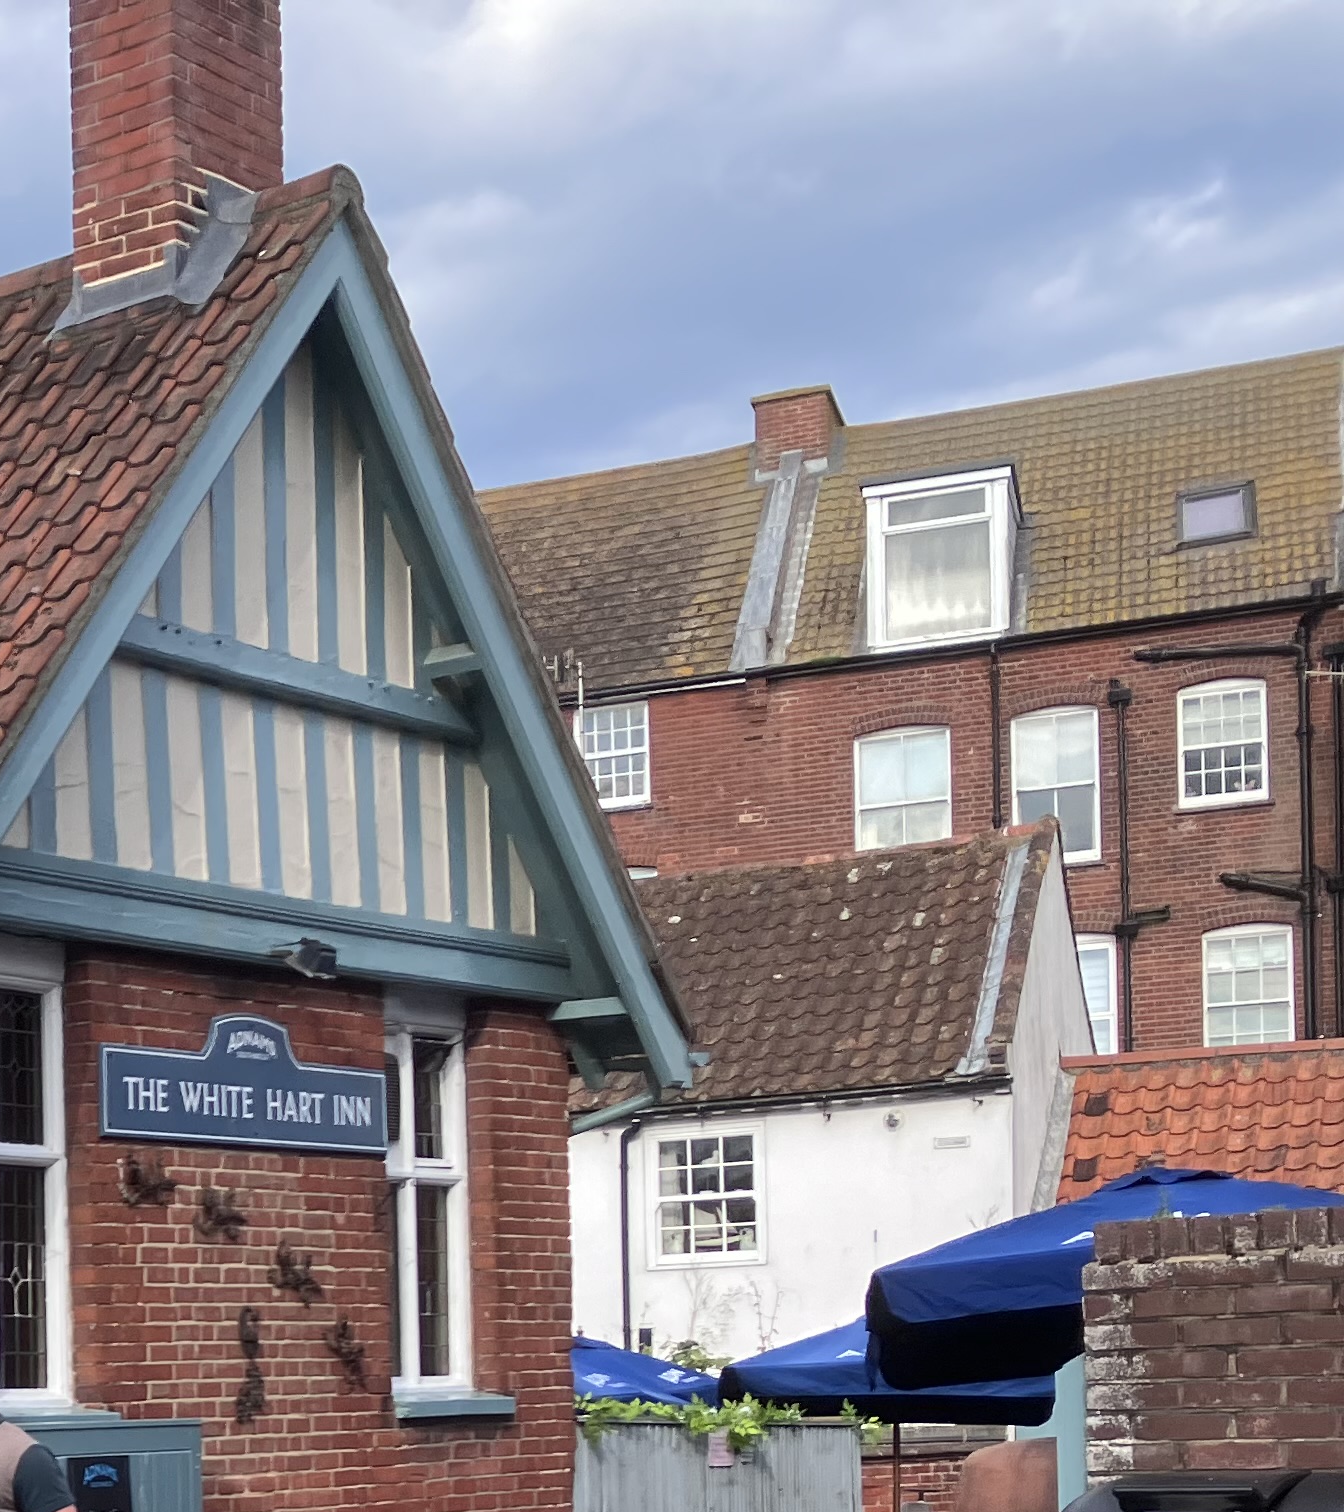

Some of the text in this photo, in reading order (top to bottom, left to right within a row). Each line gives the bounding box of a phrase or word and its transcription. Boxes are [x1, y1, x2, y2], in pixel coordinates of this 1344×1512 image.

[123, 1076, 372, 1127] THE WHITE HART INN
